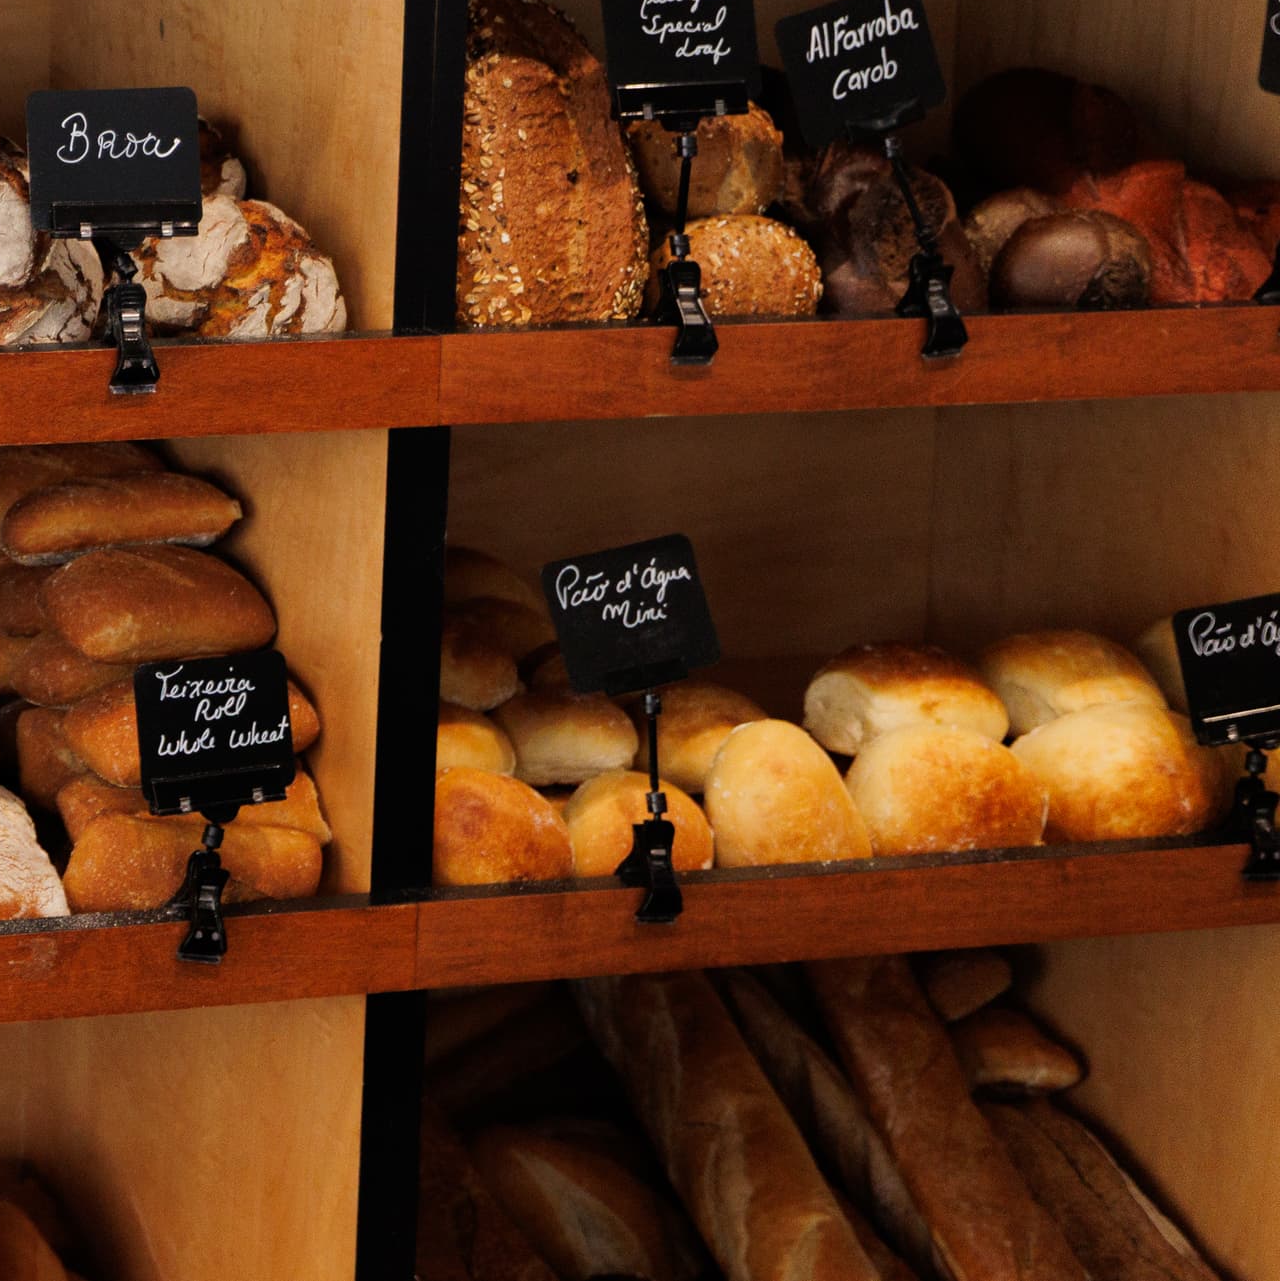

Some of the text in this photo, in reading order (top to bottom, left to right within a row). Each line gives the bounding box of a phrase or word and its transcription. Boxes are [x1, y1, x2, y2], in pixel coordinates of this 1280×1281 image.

[56, 110, 182, 165] Broa
[601, 600, 669, 628] Mini
[155, 665, 256, 701] Teixeira
[193, 693, 247, 722] Roll
